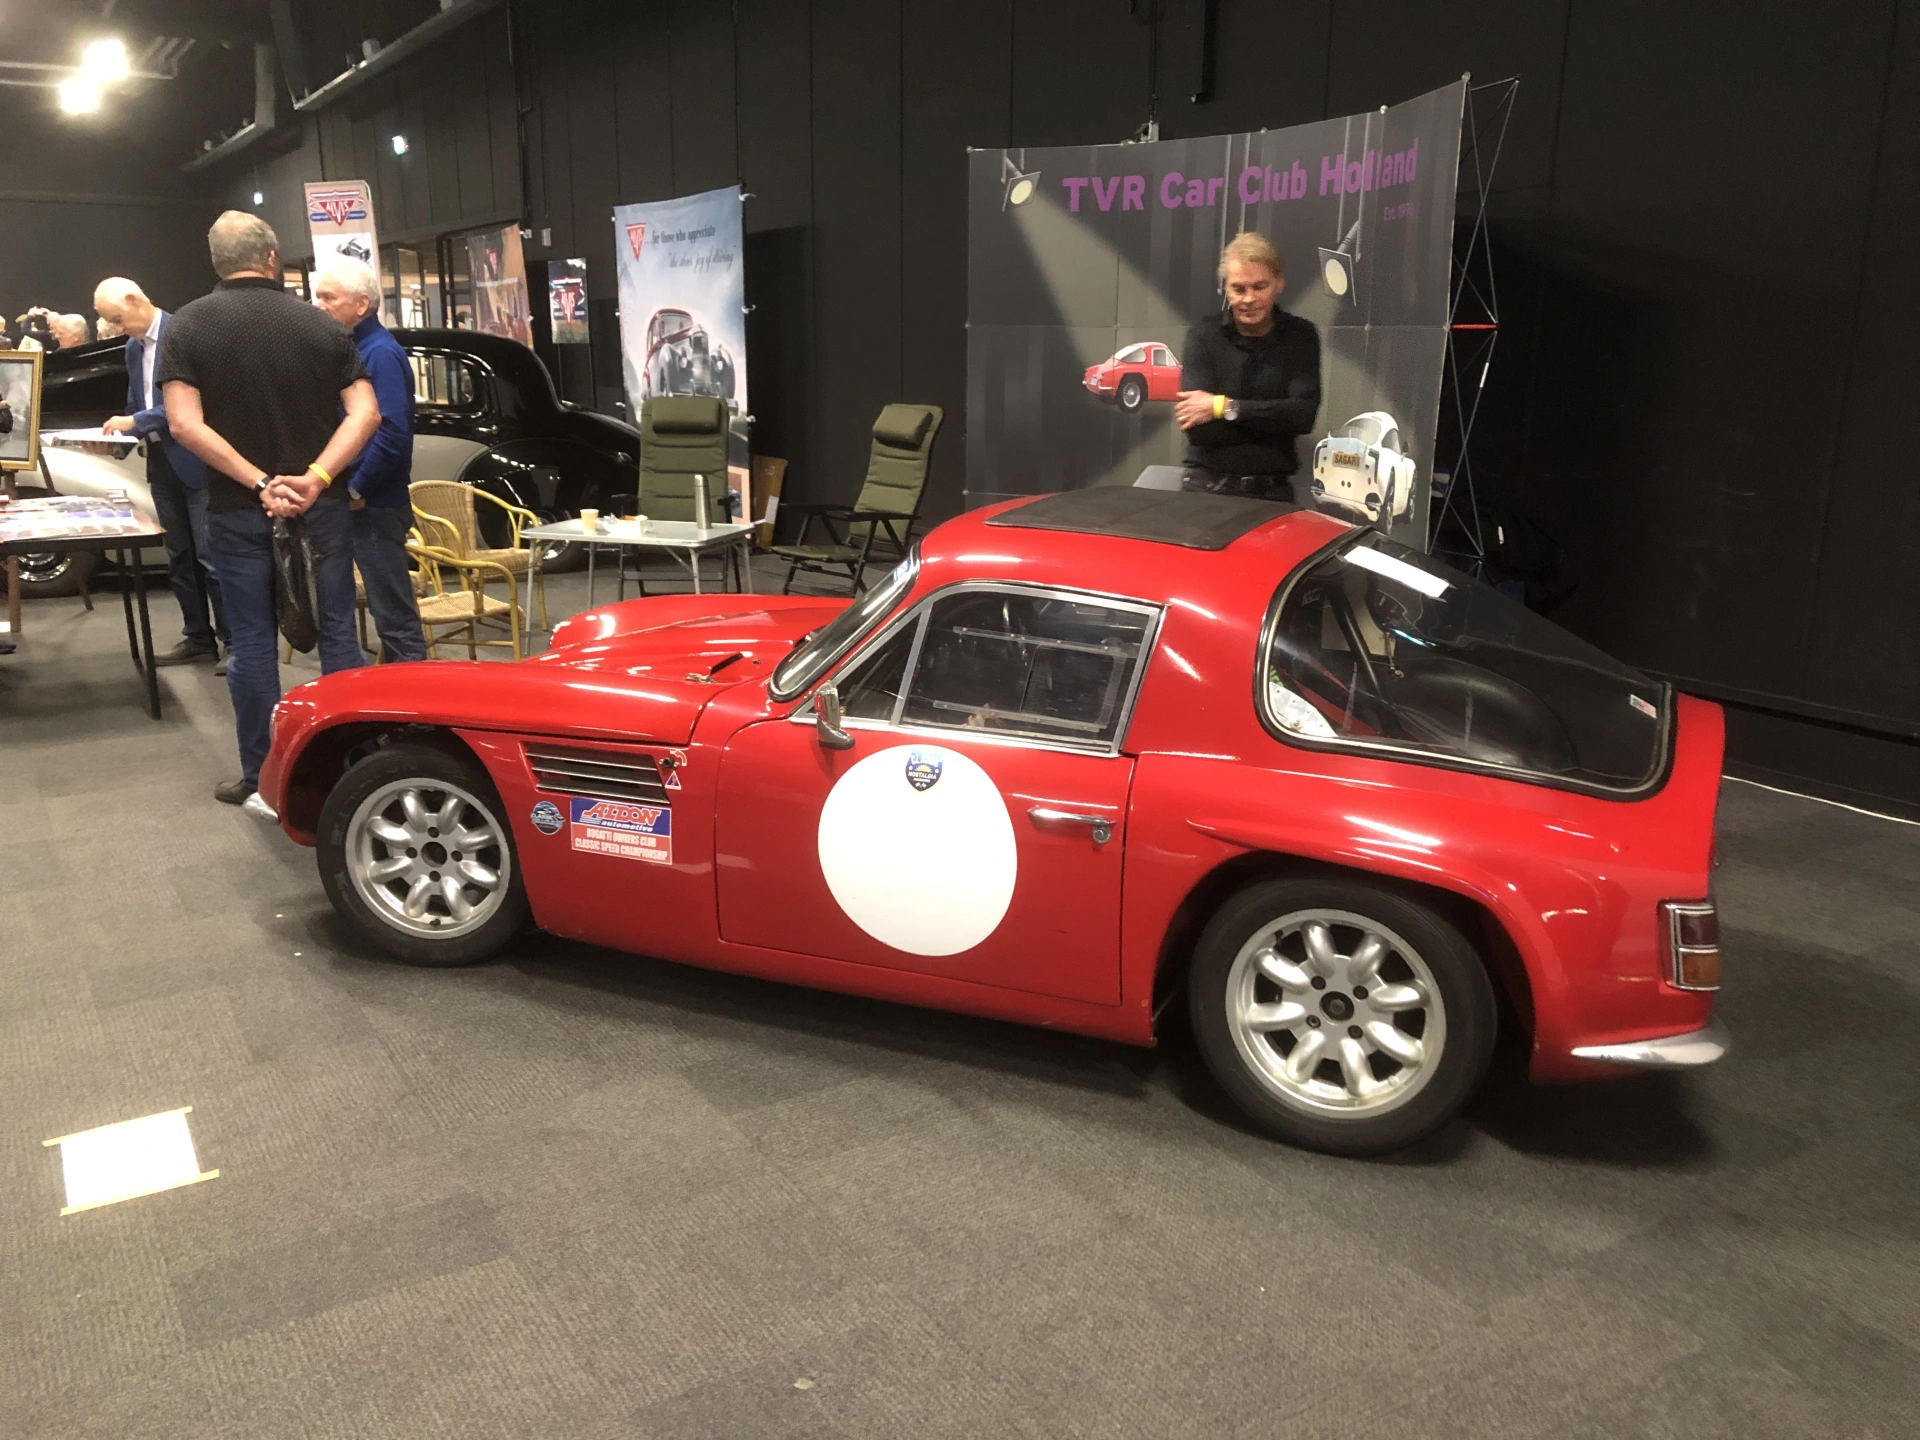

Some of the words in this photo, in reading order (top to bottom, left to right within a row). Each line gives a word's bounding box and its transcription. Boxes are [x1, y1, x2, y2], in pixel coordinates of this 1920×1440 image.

[1062, 175, 1146, 212] TVR
[1160, 171, 1224, 209] Car
[1238, 160, 1308, 205] Club
[1319, 136, 1420, 197] Holland
[325, 200, 350, 223] ALVIS
[581, 802, 662, 826] ALDON
[586, 827, 613, 842] BUGATTI
[613, 832, 640, 846] OWNERS
[639, 836, 657, 848] CLUB
[601, 820, 654, 832] automotive
[574, 837, 601, 851] CLASSIC
[601, 841, 620, 854] SPEED
[620, 845, 668, 861] CHAMPIONSHIP
